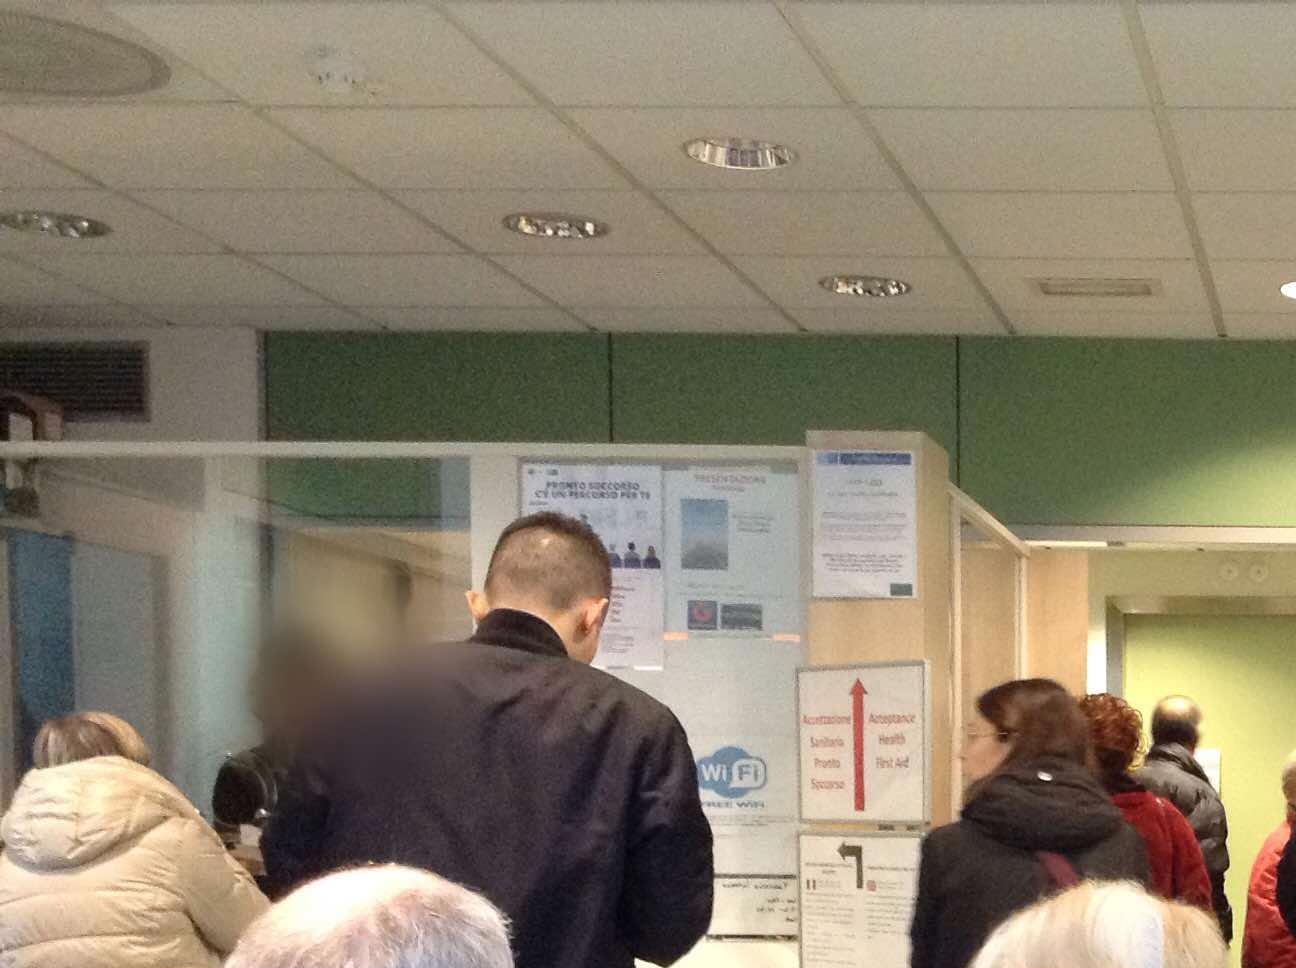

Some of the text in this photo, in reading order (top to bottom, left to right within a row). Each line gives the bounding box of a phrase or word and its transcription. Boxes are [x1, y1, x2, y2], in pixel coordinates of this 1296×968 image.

[879, 732, 906, 746] Health
[814, 757, 841, 769] Pronto
[876, 755, 909, 769] First Aid
[810, 778, 846, 791] Soccorso
